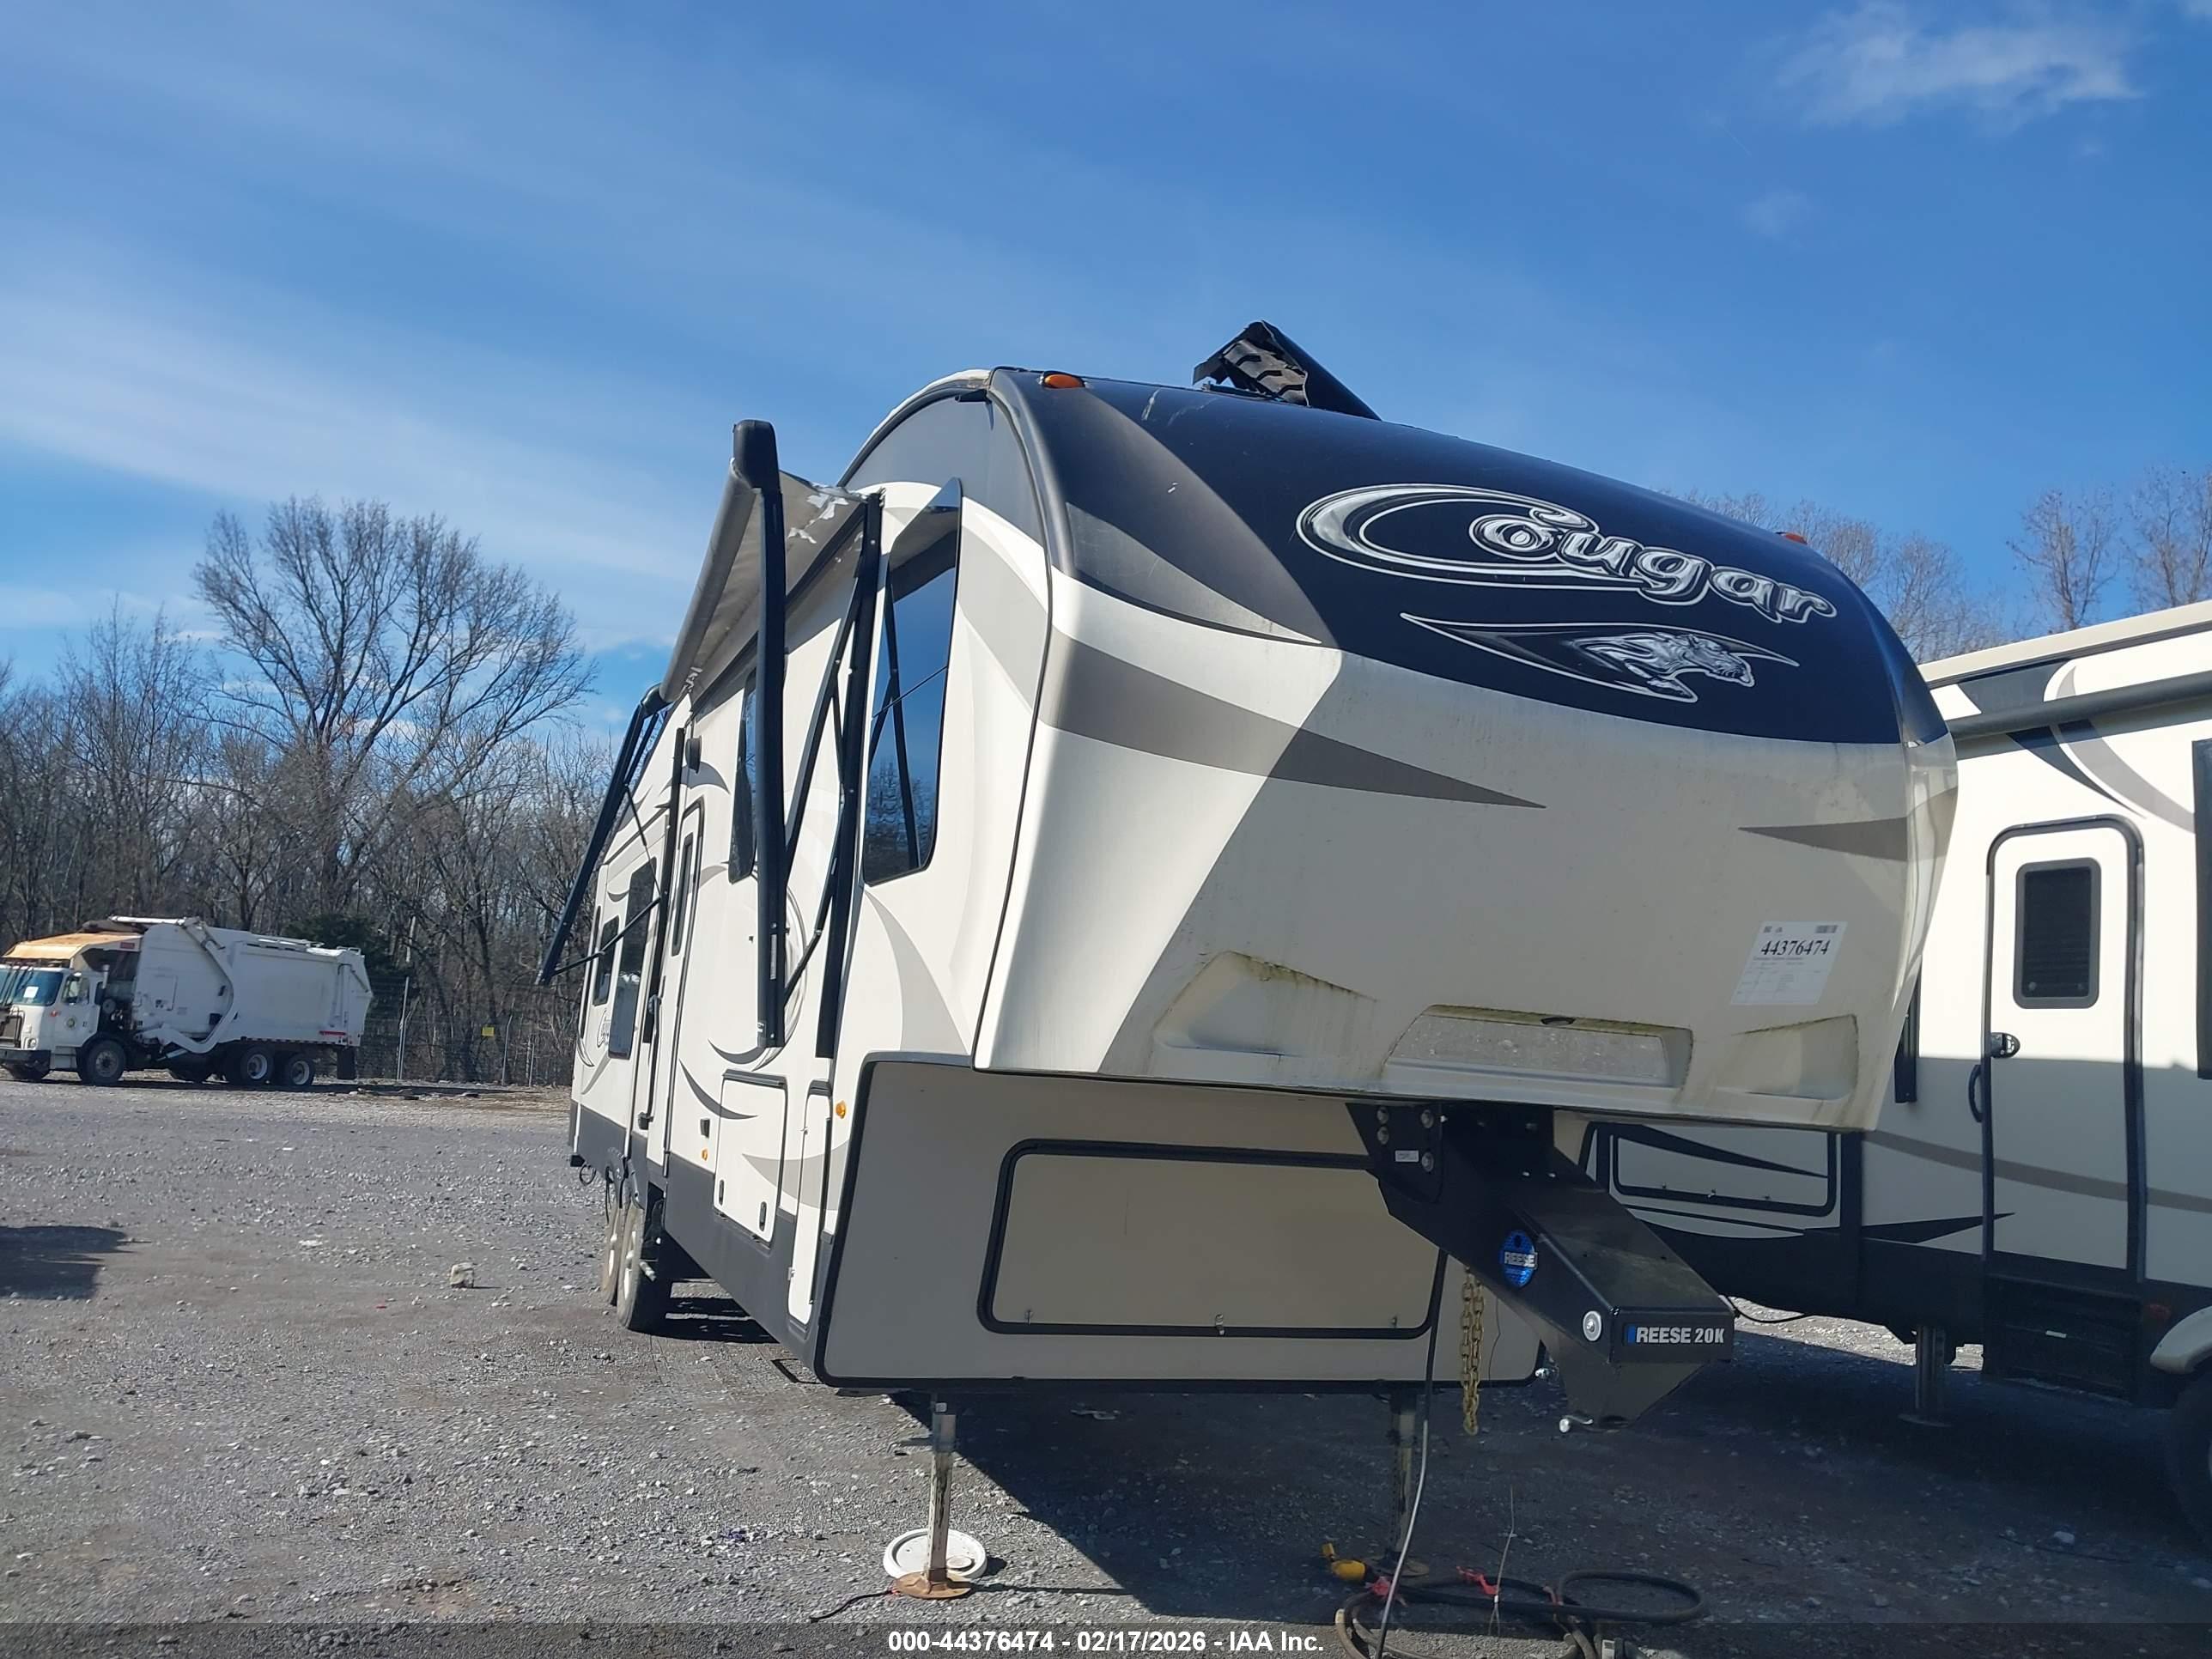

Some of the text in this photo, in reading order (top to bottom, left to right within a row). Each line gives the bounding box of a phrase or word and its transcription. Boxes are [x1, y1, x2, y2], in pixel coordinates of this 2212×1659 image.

[1296, 483, 1838, 624] Cougar
[1761, 939, 1831, 956] 44376474
[1504, 1251, 1535, 1268] REESE
[1636, 1327, 1725, 1343] REESE 20K
